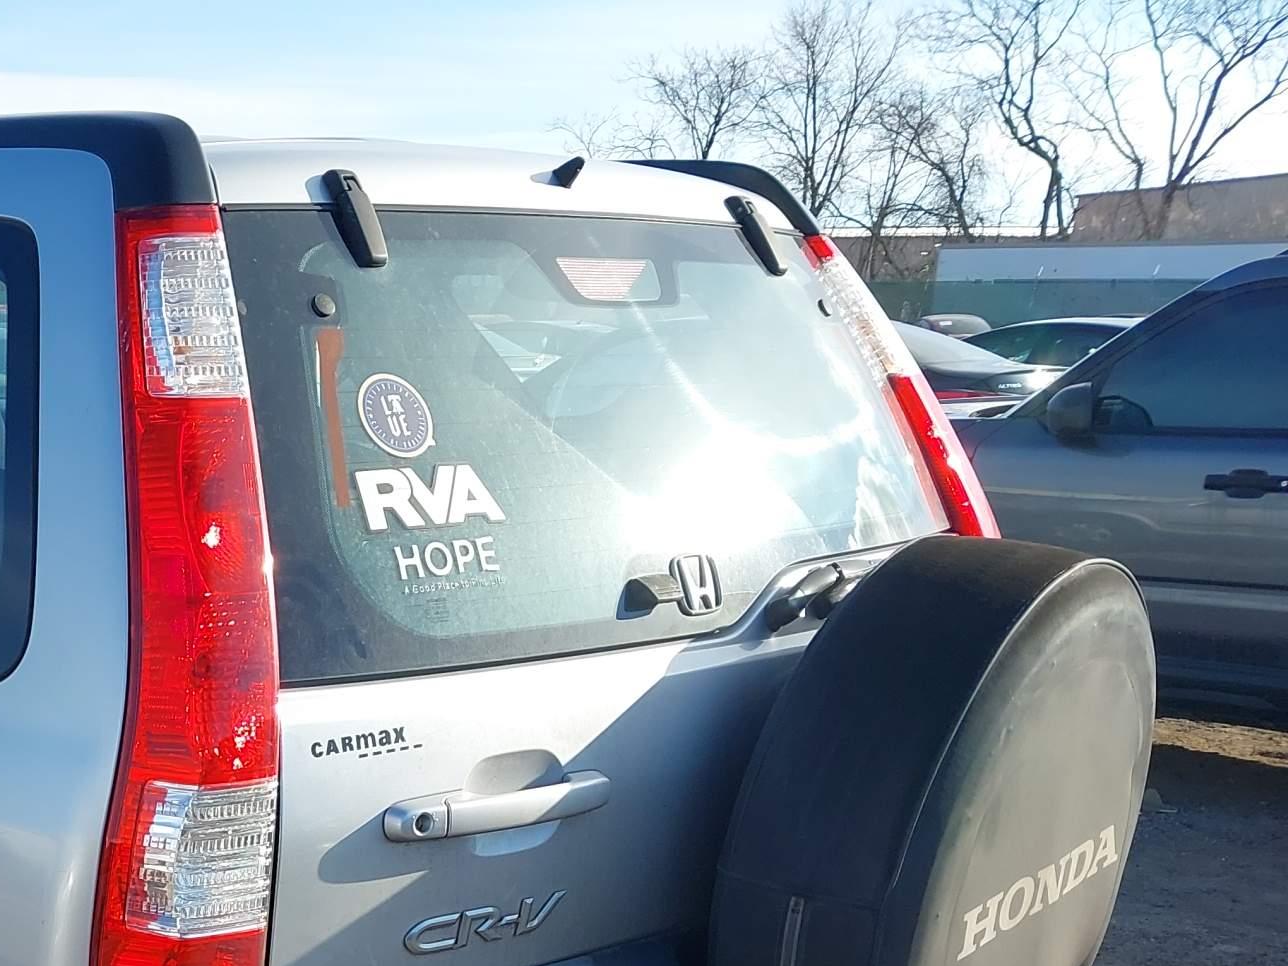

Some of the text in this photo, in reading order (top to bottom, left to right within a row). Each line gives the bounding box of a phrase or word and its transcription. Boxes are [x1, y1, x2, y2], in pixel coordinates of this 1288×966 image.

[354, 464, 506, 532] RVA
[393, 536, 502, 581] HOPE
[402, 889, 568, 956] CR-V
[957, 824, 1118, 962] HONDA
